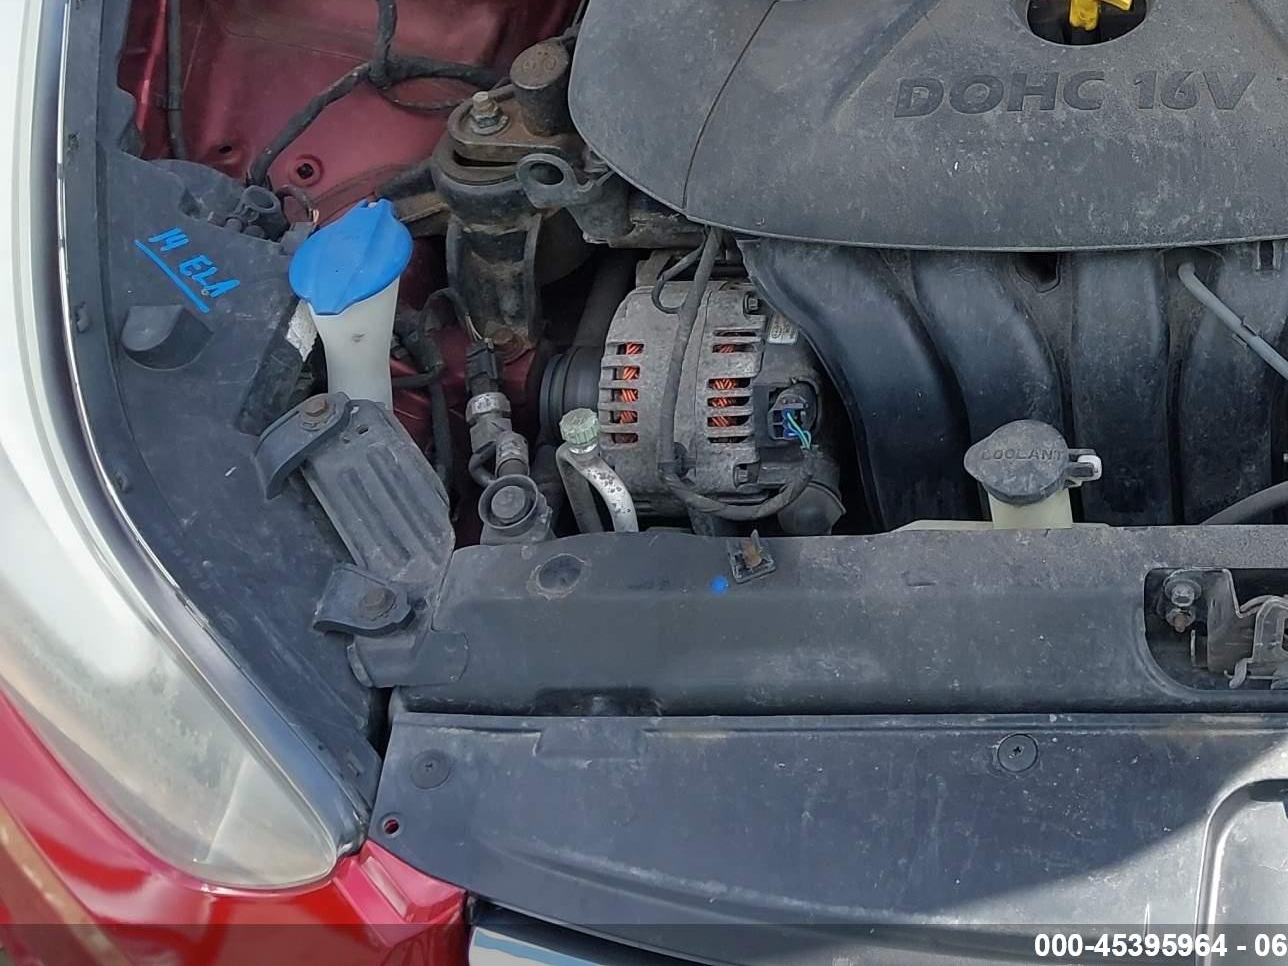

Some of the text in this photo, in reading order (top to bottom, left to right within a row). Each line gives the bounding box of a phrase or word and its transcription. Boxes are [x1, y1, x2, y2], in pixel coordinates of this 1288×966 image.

[893, 70, 1256, 119] DOHC 16V
[177, 253, 241, 298] ELA
[981, 447, 1066, 461] COOLANT
